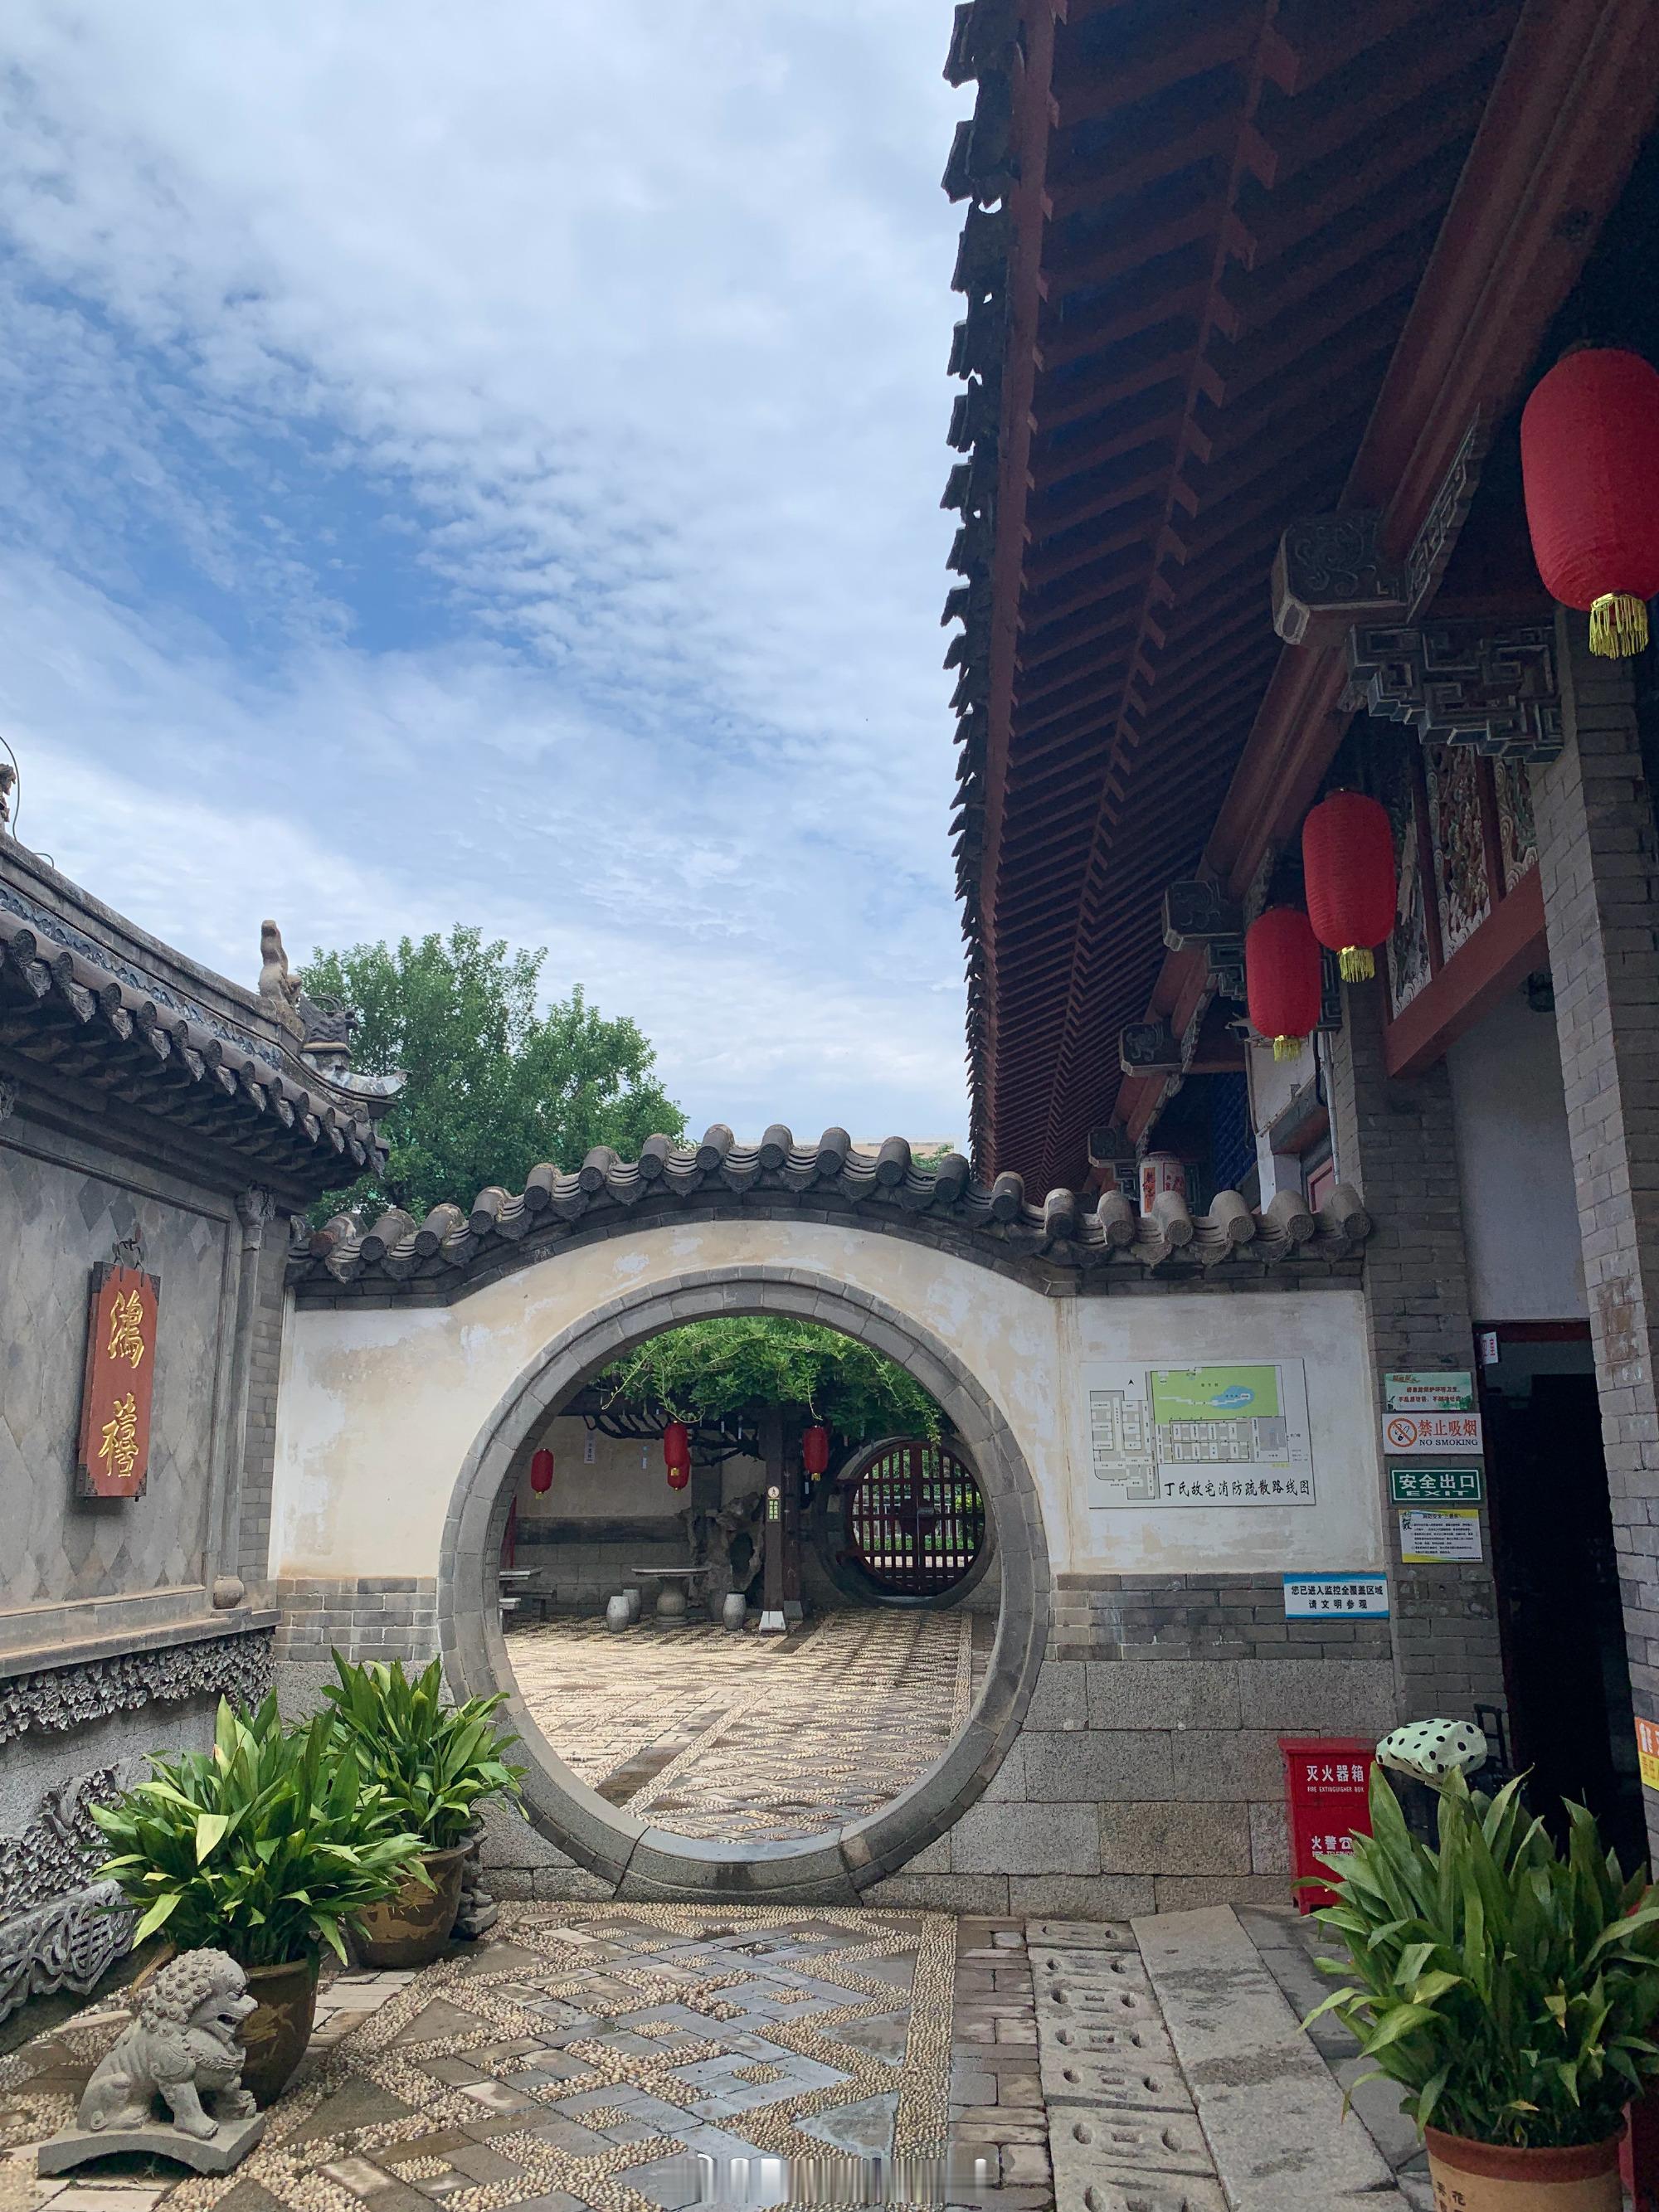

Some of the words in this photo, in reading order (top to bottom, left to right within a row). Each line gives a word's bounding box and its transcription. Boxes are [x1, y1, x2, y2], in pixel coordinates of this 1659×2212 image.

[1418, 1419, 1477, 1437] 禁止吸烟
[1164, 1478, 1310, 1498] 丁氏故宅消防疏散路线图
[1399, 1474, 1475, 1490] 安全出口
[1291, 1585, 1384, 1595] 您已进入监控全覆盖区域
[1308, 1599, 1368, 1609] 请文明参观
[1306, 1765, 1365, 1782] 灭火器箱
[1311, 1835, 1337, 1850] 火警
